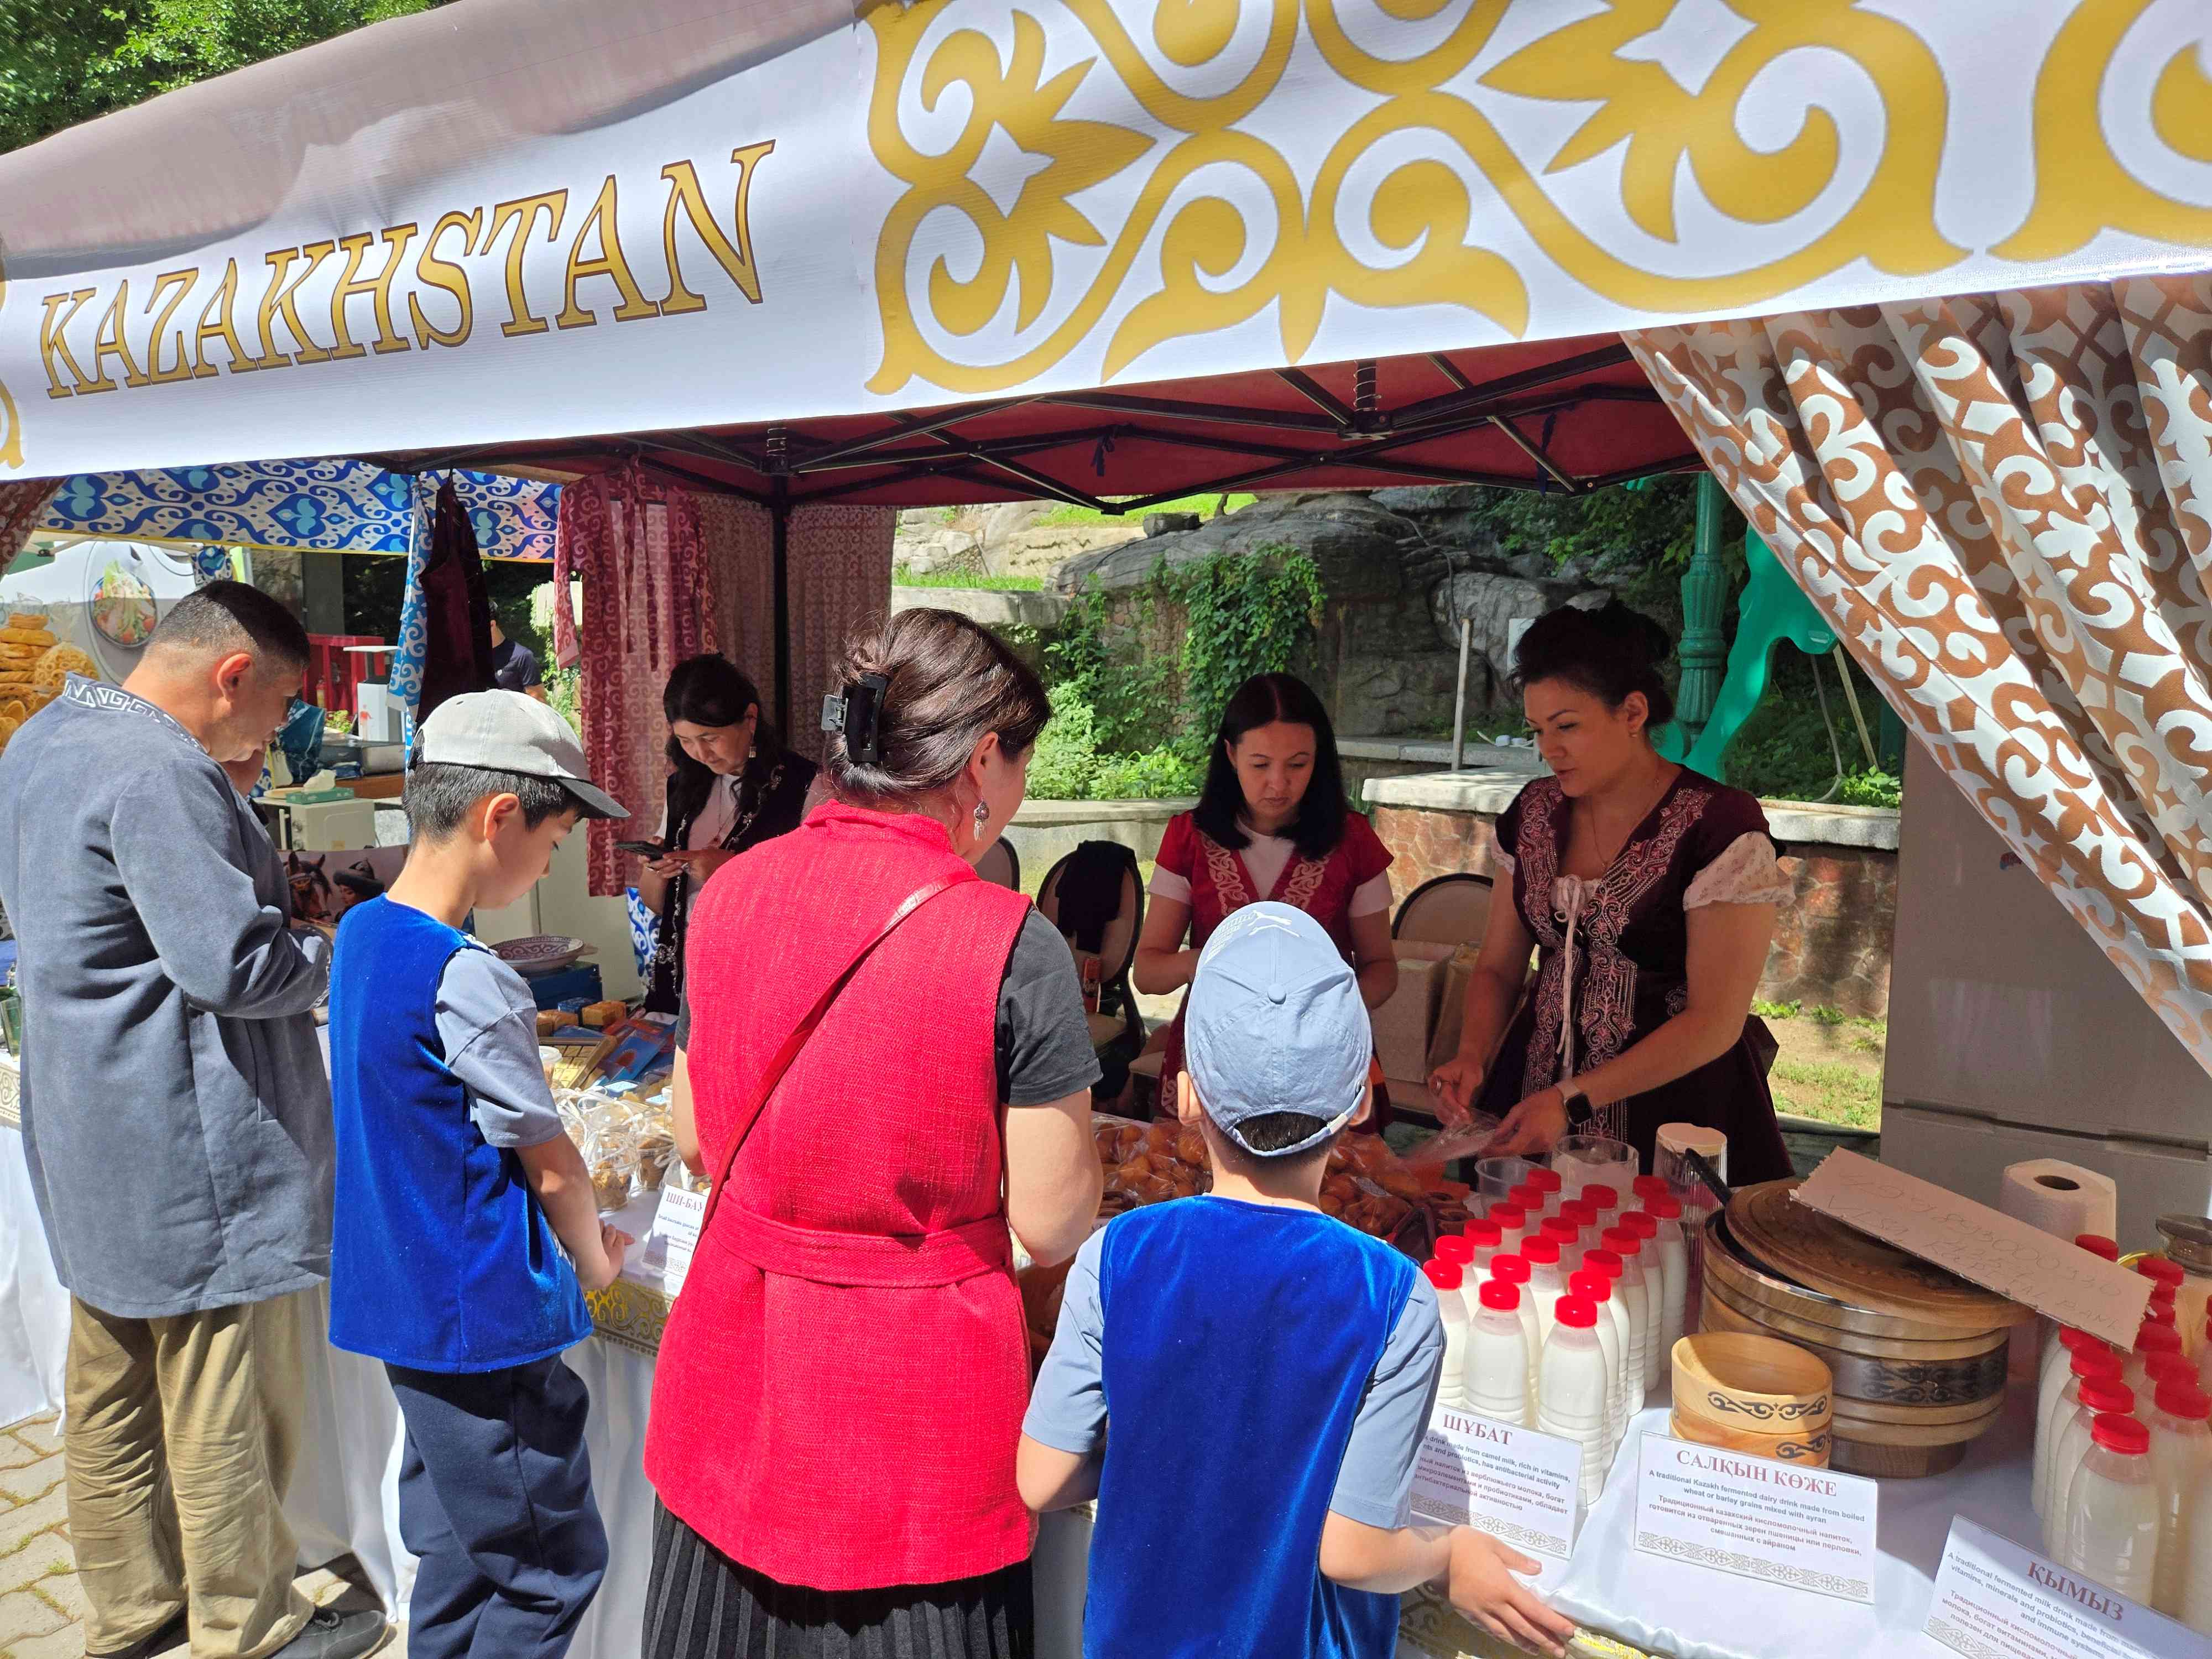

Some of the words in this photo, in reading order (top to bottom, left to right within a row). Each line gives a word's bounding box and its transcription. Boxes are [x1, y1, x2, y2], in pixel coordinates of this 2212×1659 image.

[41, 139, 775, 398] KAZAKHSTAN
[1442, 1414, 1513, 1446] ШҰБАТ
[1429, 1436, 1446, 1445] drink
[1465, 1446, 1480, 1455] from
[1481, 1451, 1500, 1461] camel
[1501, 1457, 1517, 1467] milk,
[1519, 1462, 1531, 1470] rich
[1540, 1468, 1571, 1483] vitamins,
[1434, 1446, 1446, 1454] and
[1447, 1450, 1481, 1466] probiotics,
[1482, 1460, 1493, 1469] has
[1495, 1464, 1535, 1481] antibacterial
[1536, 1477, 1560, 1490] activity
[1676, 1451, 1768, 1481] САЛҚЫН
[1773, 1472, 1837, 1497] КӨЖЕ
[1479, 1493, 1522, 1511] активностью
[1483, 1484, 1534, 1506] пробиотиками,
[1535, 1499, 1568, 1516] обладает
[1517, 1485, 1544, 1499] молока,
[1546, 1492, 1565, 1504] богат
[1656, 1470, 1691, 1484] traditional
[1693, 1478, 1719, 1490] Kazakh
[1721, 1484, 1757, 1499] fermented
[1759, 1492, 1777, 1504] dairy
[1779, 1496, 1798, 1507] drink
[1799, 1501, 1820, 1512] made
[1822, 1506, 1839, 1516] from
[1841, 1510, 1865, 1522] boiled
[1683, 1486, 1705, 1497] wheat
[1715, 1494, 1737, 1505] barley
[1739, 1499, 1762, 1511] grains
[1764, 1504, 1786, 1515] mixed
[1788, 1509, 1804, 1519] with
[1806, 1514, 1826, 1525] ayran
[1648, 1504, 1685, 1516] готовится
[1698, 1514, 1743, 1530] отваренных
[1744, 1524, 1766, 1536] зерен
[1768, 1530, 1803, 1544] пшеницы
[1806, 1538, 1820, 1546] или
[1822, 1541, 1862, 1557] перловки,
[1658, 1495, 1714, 1514] Традиционный
[1715, 1507, 1752, 1521] казахский
[1755, 1516, 1817, 1535] кисломолочный
[1819, 1531, 1852, 1545] напиток,
[1710, 1527, 1754, 1542] смешанных
[1762, 1537, 1796, 1552] айраном
[1948, 1589, 2009, 1627] Традиционный
[1950, 1564, 1984, 1587] vitamins,
[1985, 1582, 2018, 1604] minerals
[2020, 1599, 2036, 1612] and
[2036, 1608, 2079, 1636] probiotics,
[1955, 1555, 1992, 1578] traditional
[1994, 1574, 2033, 1599] fermented
[2034, 1595, 2052, 1609] milk
[2052, 1604, 2074, 1620] drink
[2075, 1615, 2098, 1632] made
[2027, 1561, 2124, 1621] ҚЫМЫЗ
[1940, 1598, 1972, 1620] молока,
[1973, 1613, 1996, 1631] богат
[1950, 1614, 1982, 1635] полезен
[1982, 1631, 1999, 1645] для
[2020, 1610, 2036, 1623] and
[2037, 1619, 2070, 1641] immune
